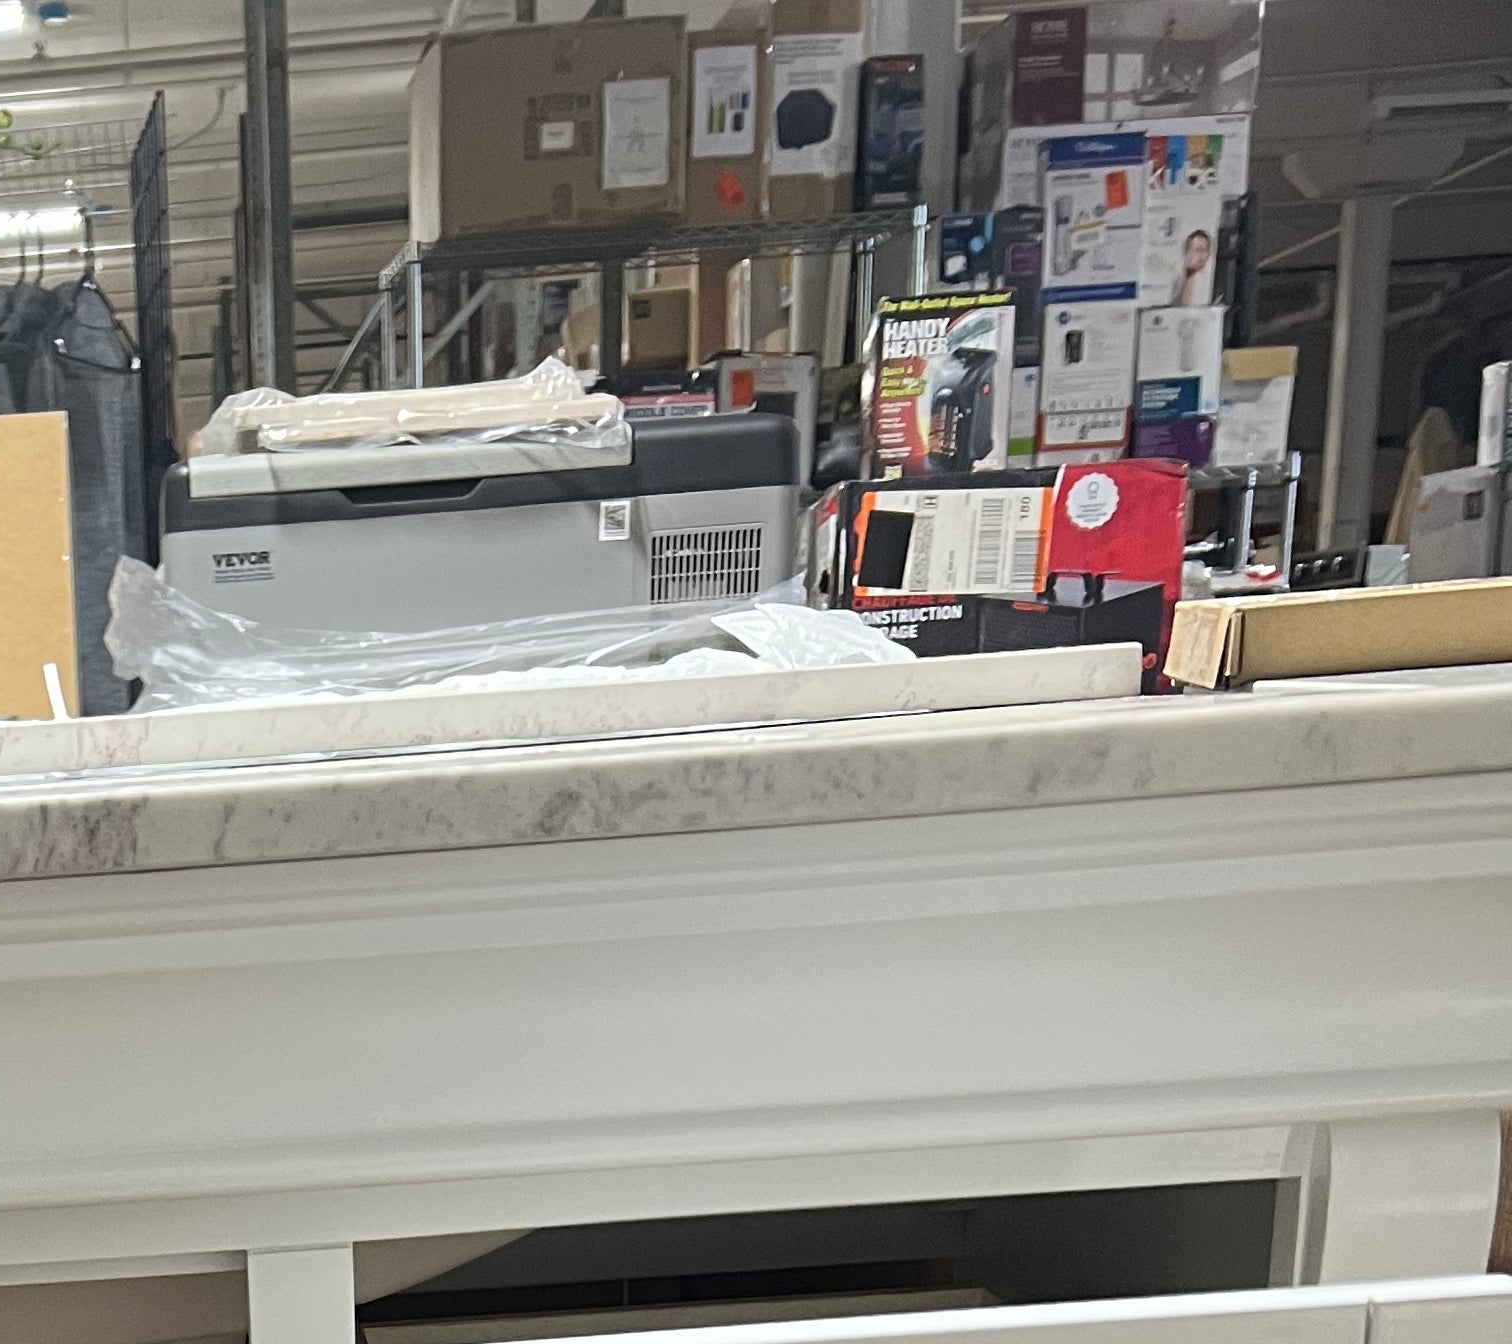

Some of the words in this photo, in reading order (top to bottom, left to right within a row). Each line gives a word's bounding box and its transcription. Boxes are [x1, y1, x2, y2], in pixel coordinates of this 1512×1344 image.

[884, 317, 950, 342] HANDY
[883, 337, 949, 361] HEATER
[212, 551, 271, 567] VEVOR
[860, 605, 963, 625] ONSTRUCTION
[881, 624, 919, 640] RAGE
